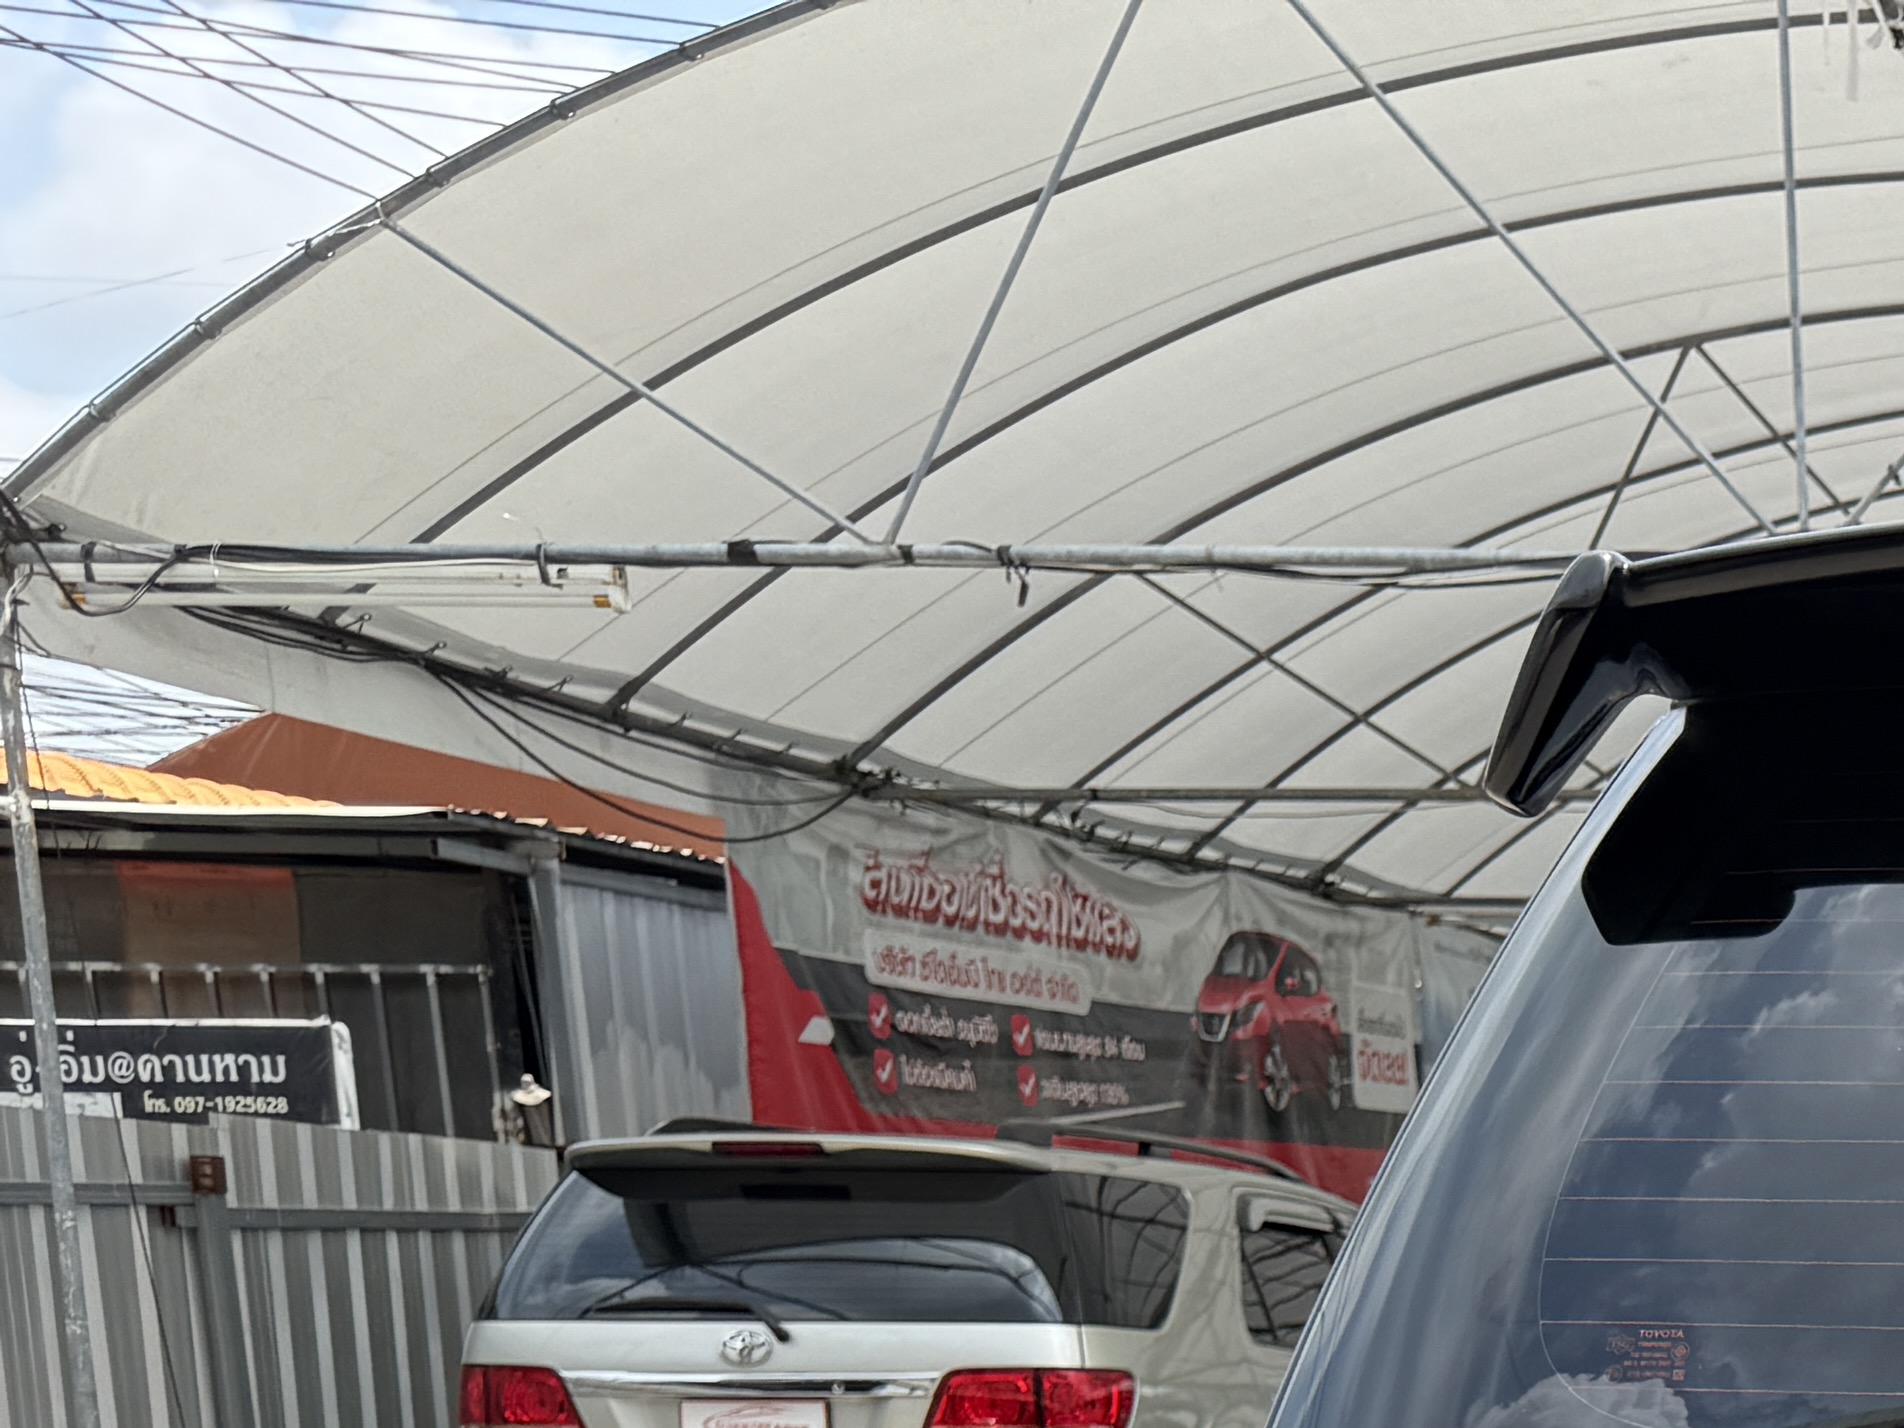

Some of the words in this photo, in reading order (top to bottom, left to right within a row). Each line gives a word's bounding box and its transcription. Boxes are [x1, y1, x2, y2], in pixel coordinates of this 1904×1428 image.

[143, 1089, 170, 1113] โทร.
[173, 1096, 288, 1114] 097-1925628
[1639, 1329, 1685, 1338] TOYOTA
